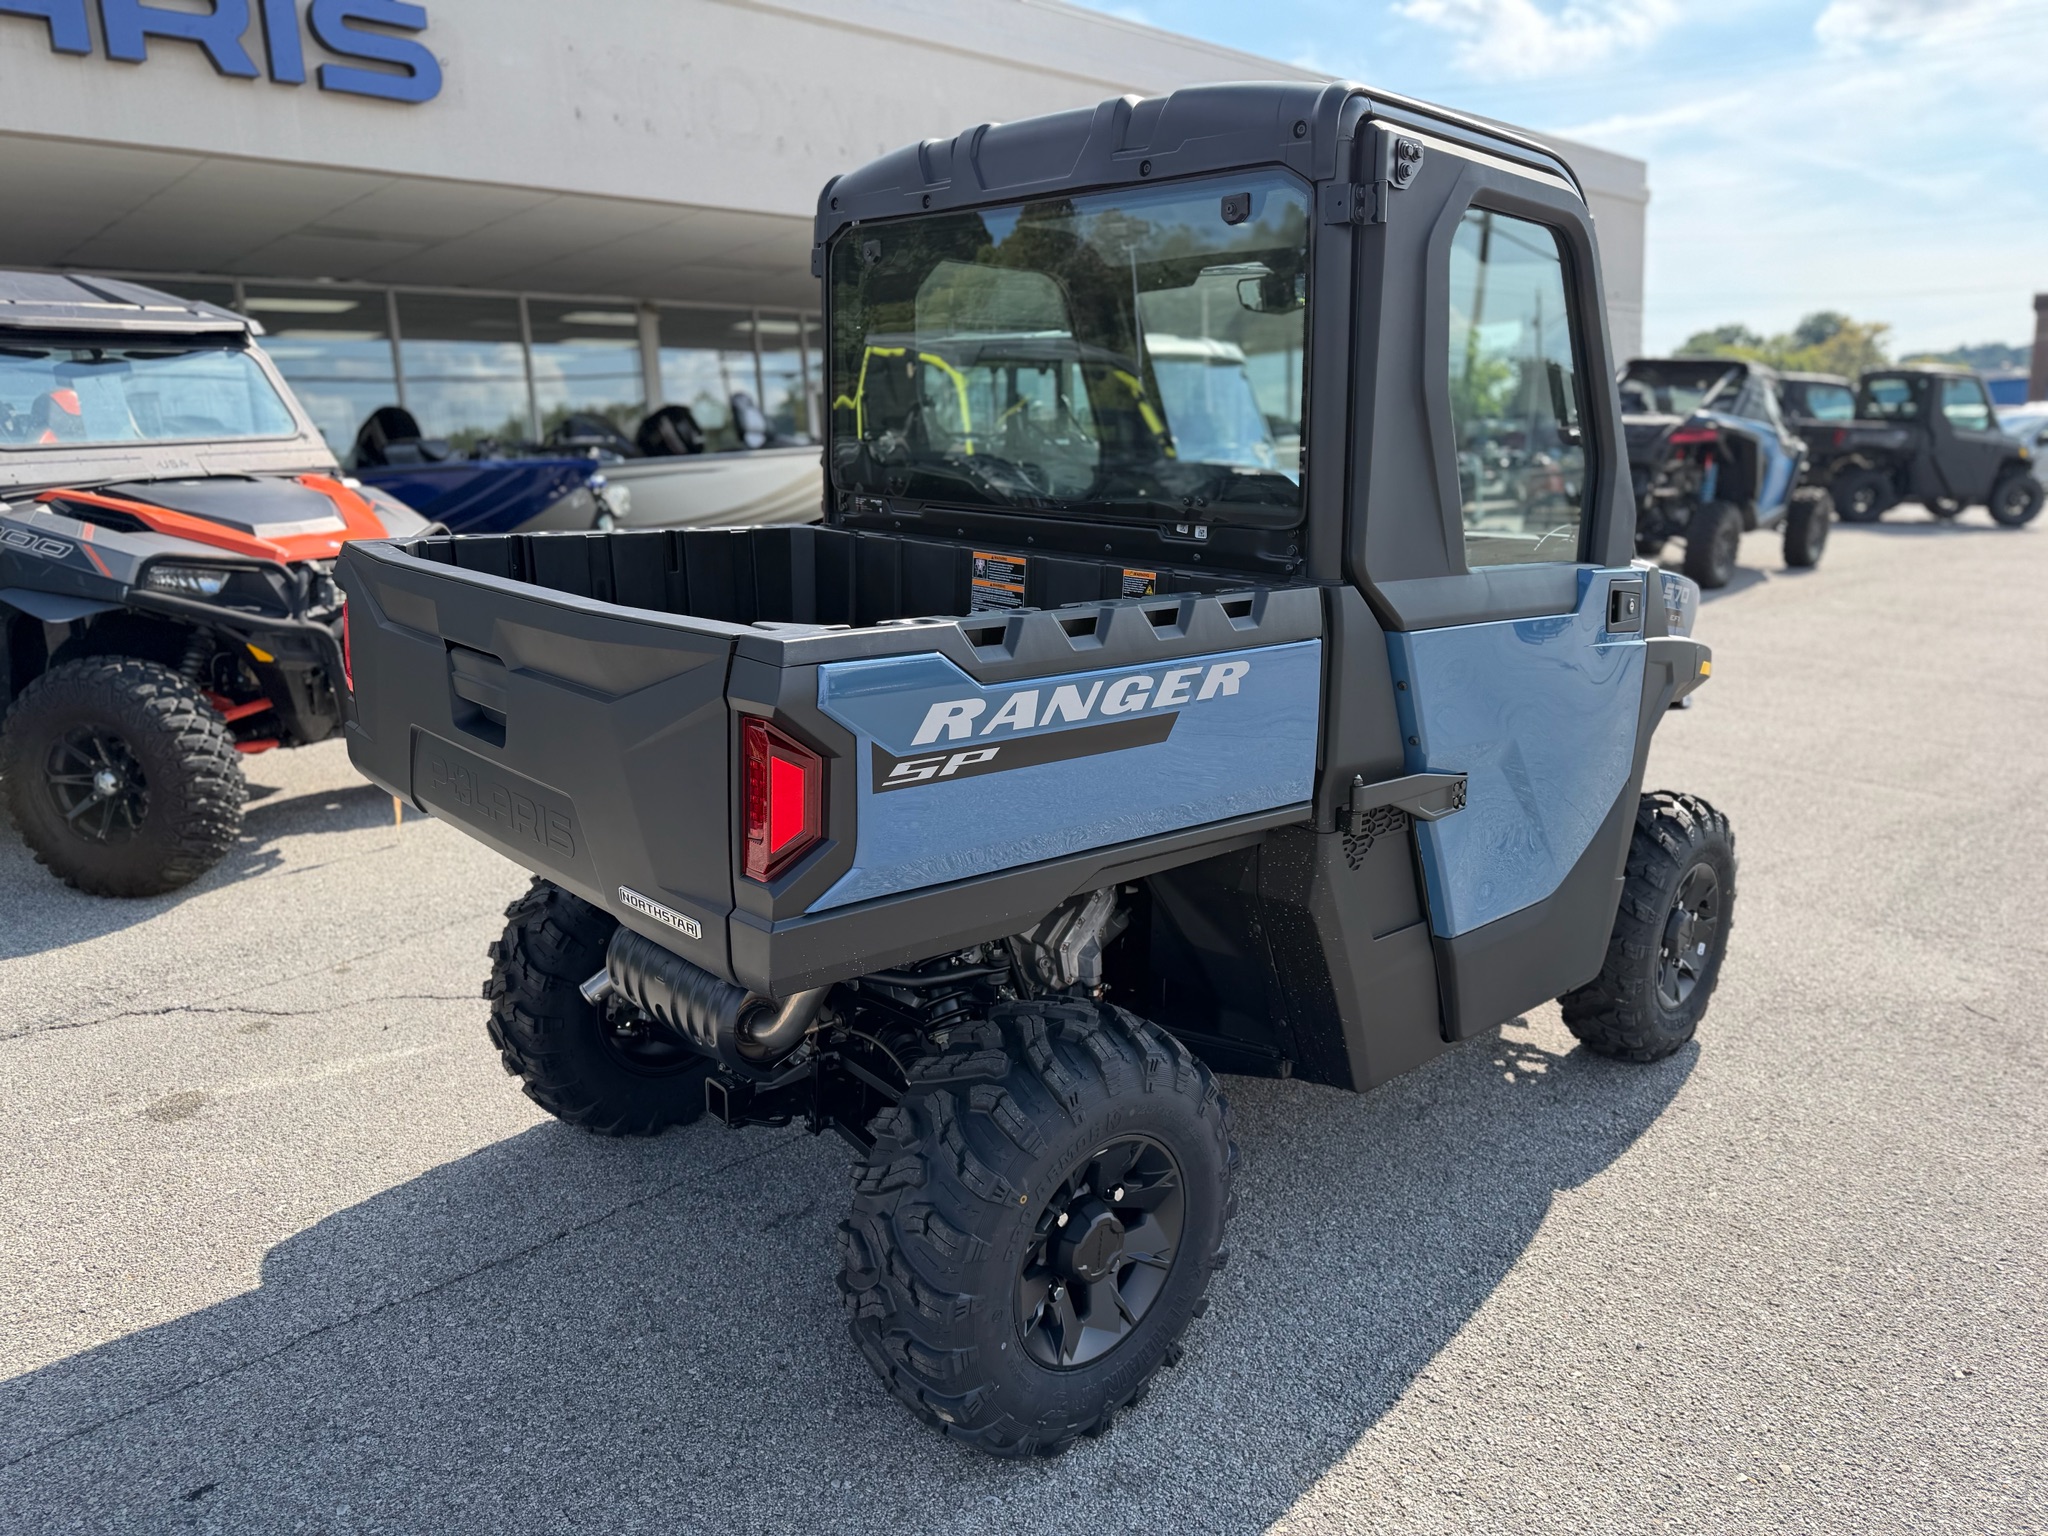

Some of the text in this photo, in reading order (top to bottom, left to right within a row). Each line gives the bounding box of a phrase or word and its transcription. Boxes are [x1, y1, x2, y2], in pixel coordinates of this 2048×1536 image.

[1662, 583, 1690, 604] 570
[910, 660, 1250, 746] RANGER
[881, 746, 1001, 787] SP
[427, 751, 576, 861] POLARIS
[622, 891, 695, 935] NORTHSTAR
